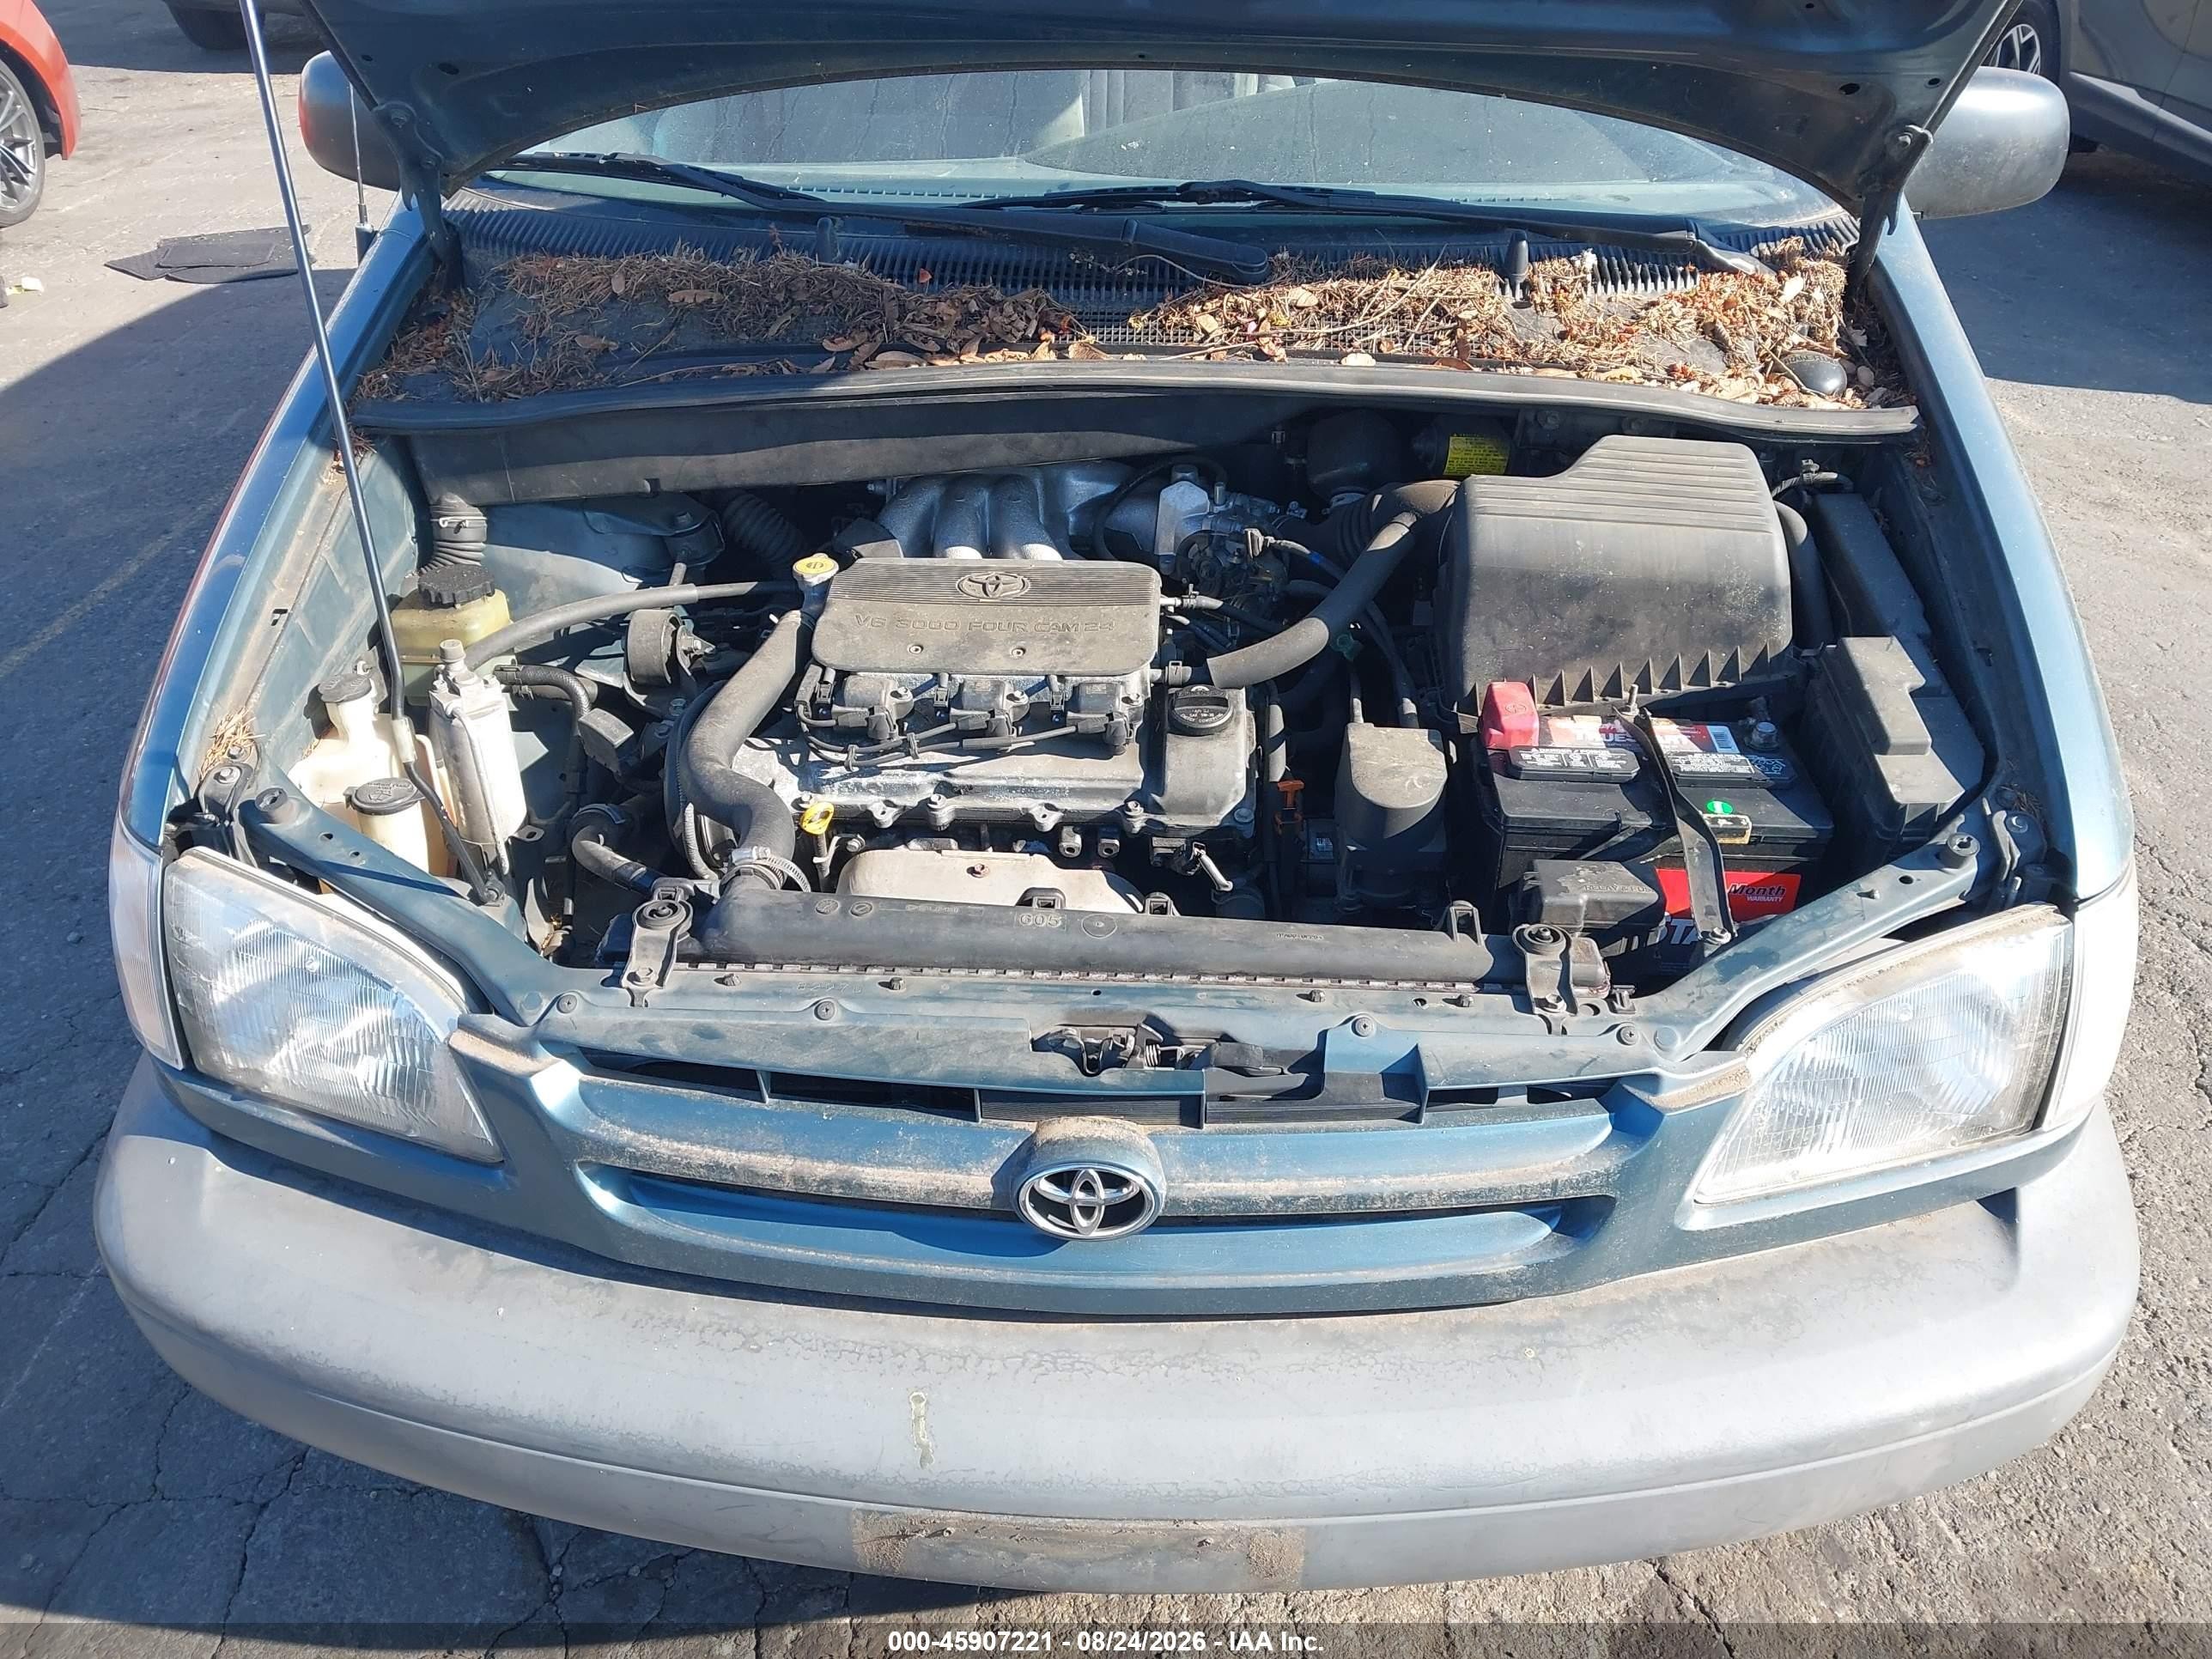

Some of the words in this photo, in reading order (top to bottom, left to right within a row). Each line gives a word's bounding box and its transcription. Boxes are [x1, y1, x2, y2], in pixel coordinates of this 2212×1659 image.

[855, 614, 887, 628] V6
[896, 617, 960, 630] 3000
[968, 621, 1027, 633] FOUR
[1033, 622, 1080, 633] CAM
[1727, 883, 1786, 896] Month
